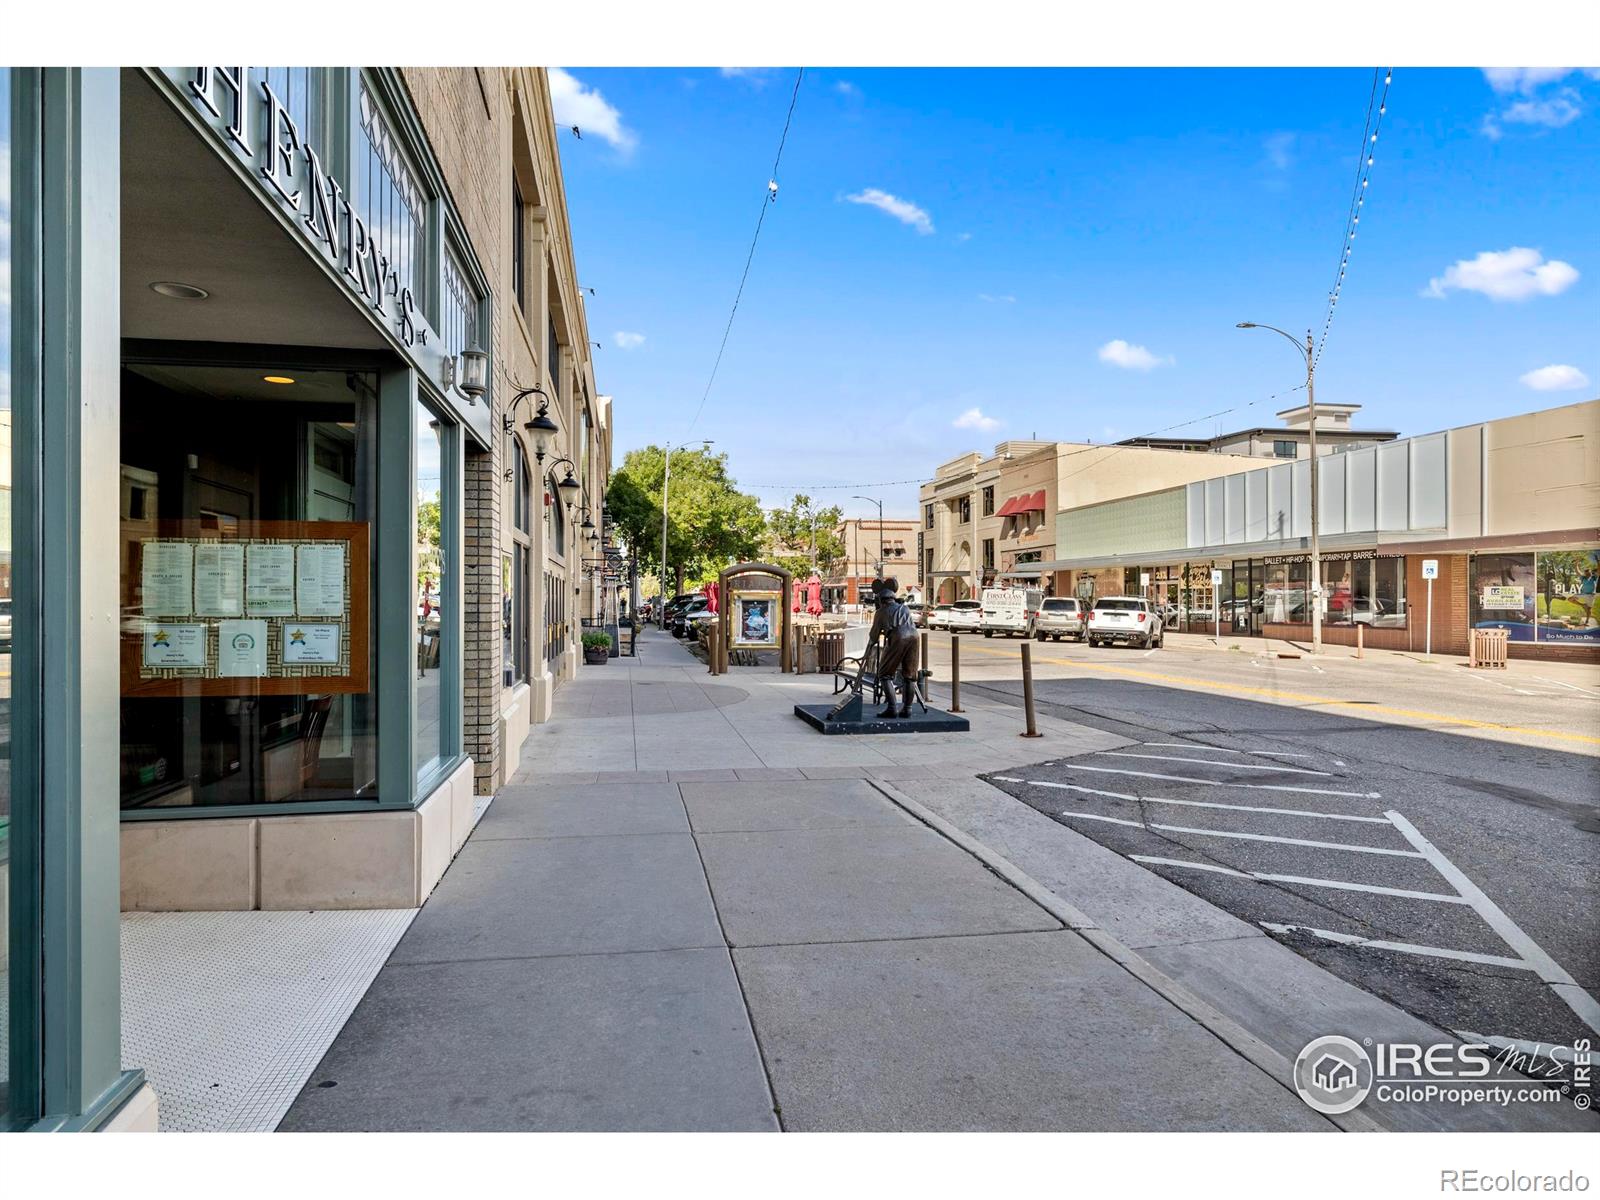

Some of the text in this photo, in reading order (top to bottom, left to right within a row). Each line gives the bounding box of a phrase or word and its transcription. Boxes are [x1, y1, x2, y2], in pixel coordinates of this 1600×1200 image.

[188, 67, 414, 348] HENRY'S
[1264, 557, 1282, 565] BALLET
[1353, 551, 1373, 559] BARRE
[1555, 583, 1583, 594] PLAY
[1003, 591, 1023, 599] CLASS
